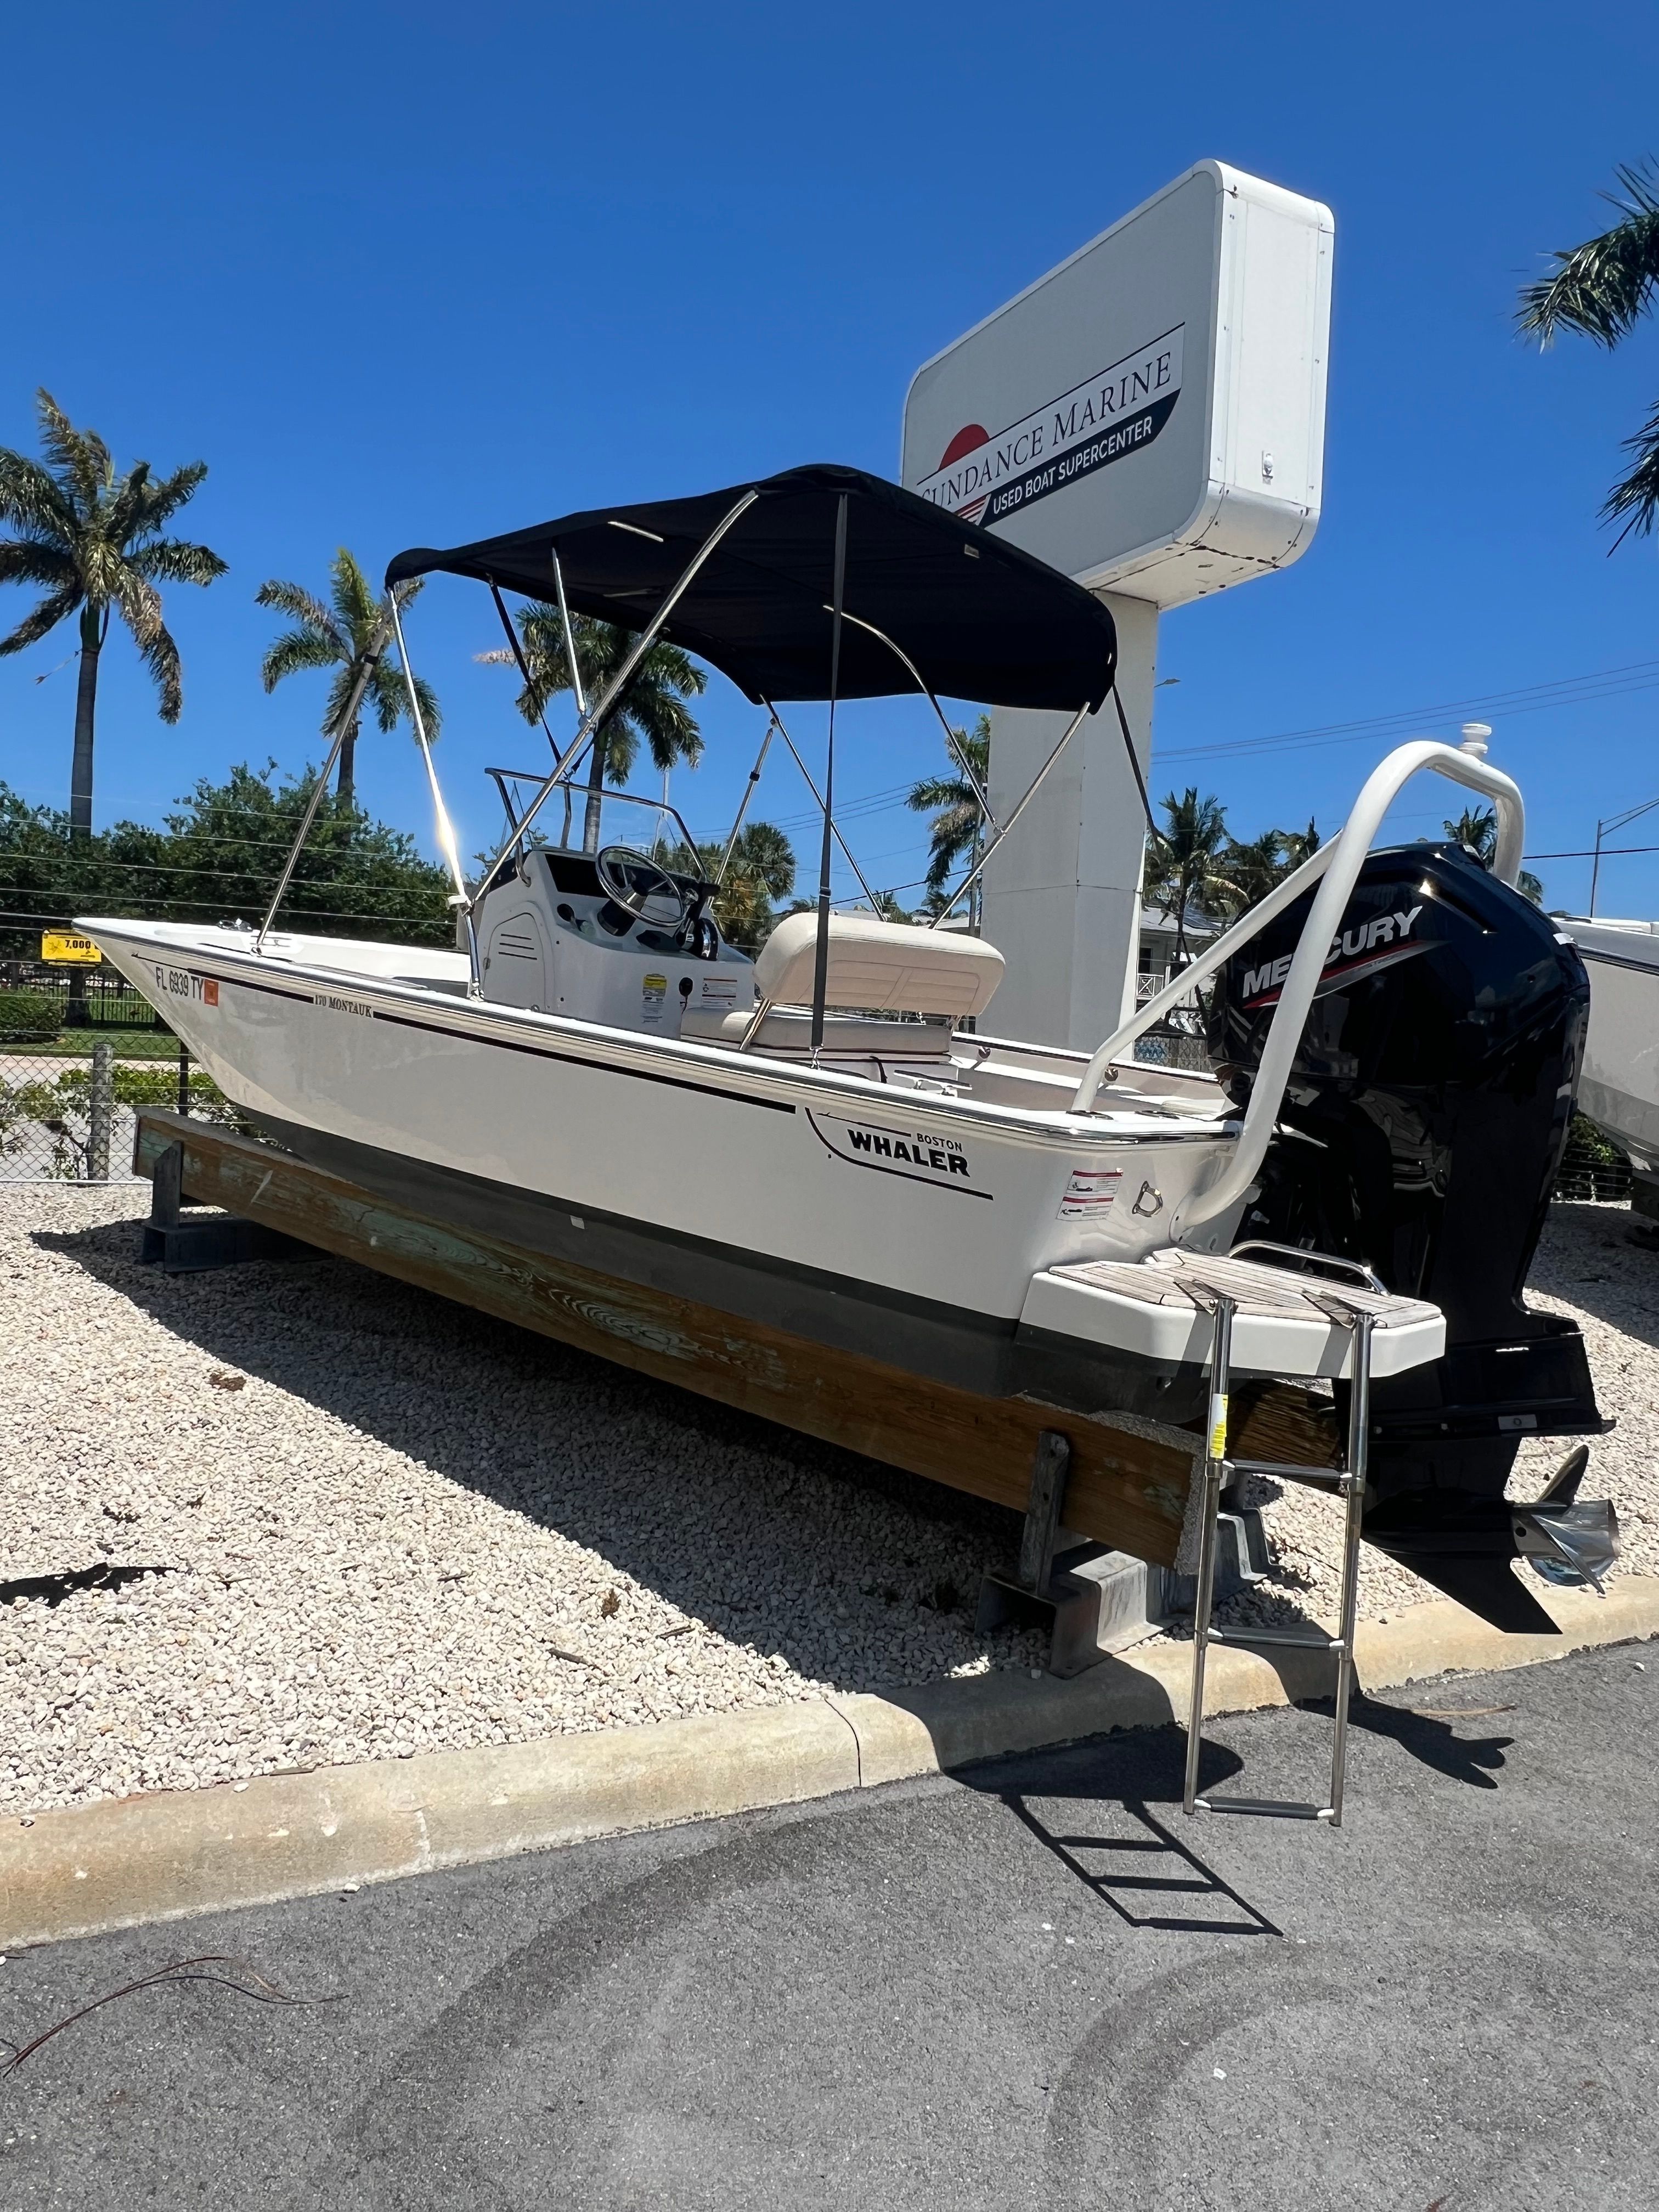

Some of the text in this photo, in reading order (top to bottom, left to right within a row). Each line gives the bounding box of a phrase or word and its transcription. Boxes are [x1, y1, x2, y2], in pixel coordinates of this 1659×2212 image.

[1052, 351, 1172, 447] MARINE
[993, 415, 1153, 515] USED BOAT SUPERCENTER
[65, 939, 91, 949] 7,000
[1242, 905, 1423, 998] MECURY
[155, 966, 168, 990] FL
[190, 975, 204, 1001] TY
[847, 1128, 971, 1178] WHALER
[916, 1132, 963, 1153] BOSTON
